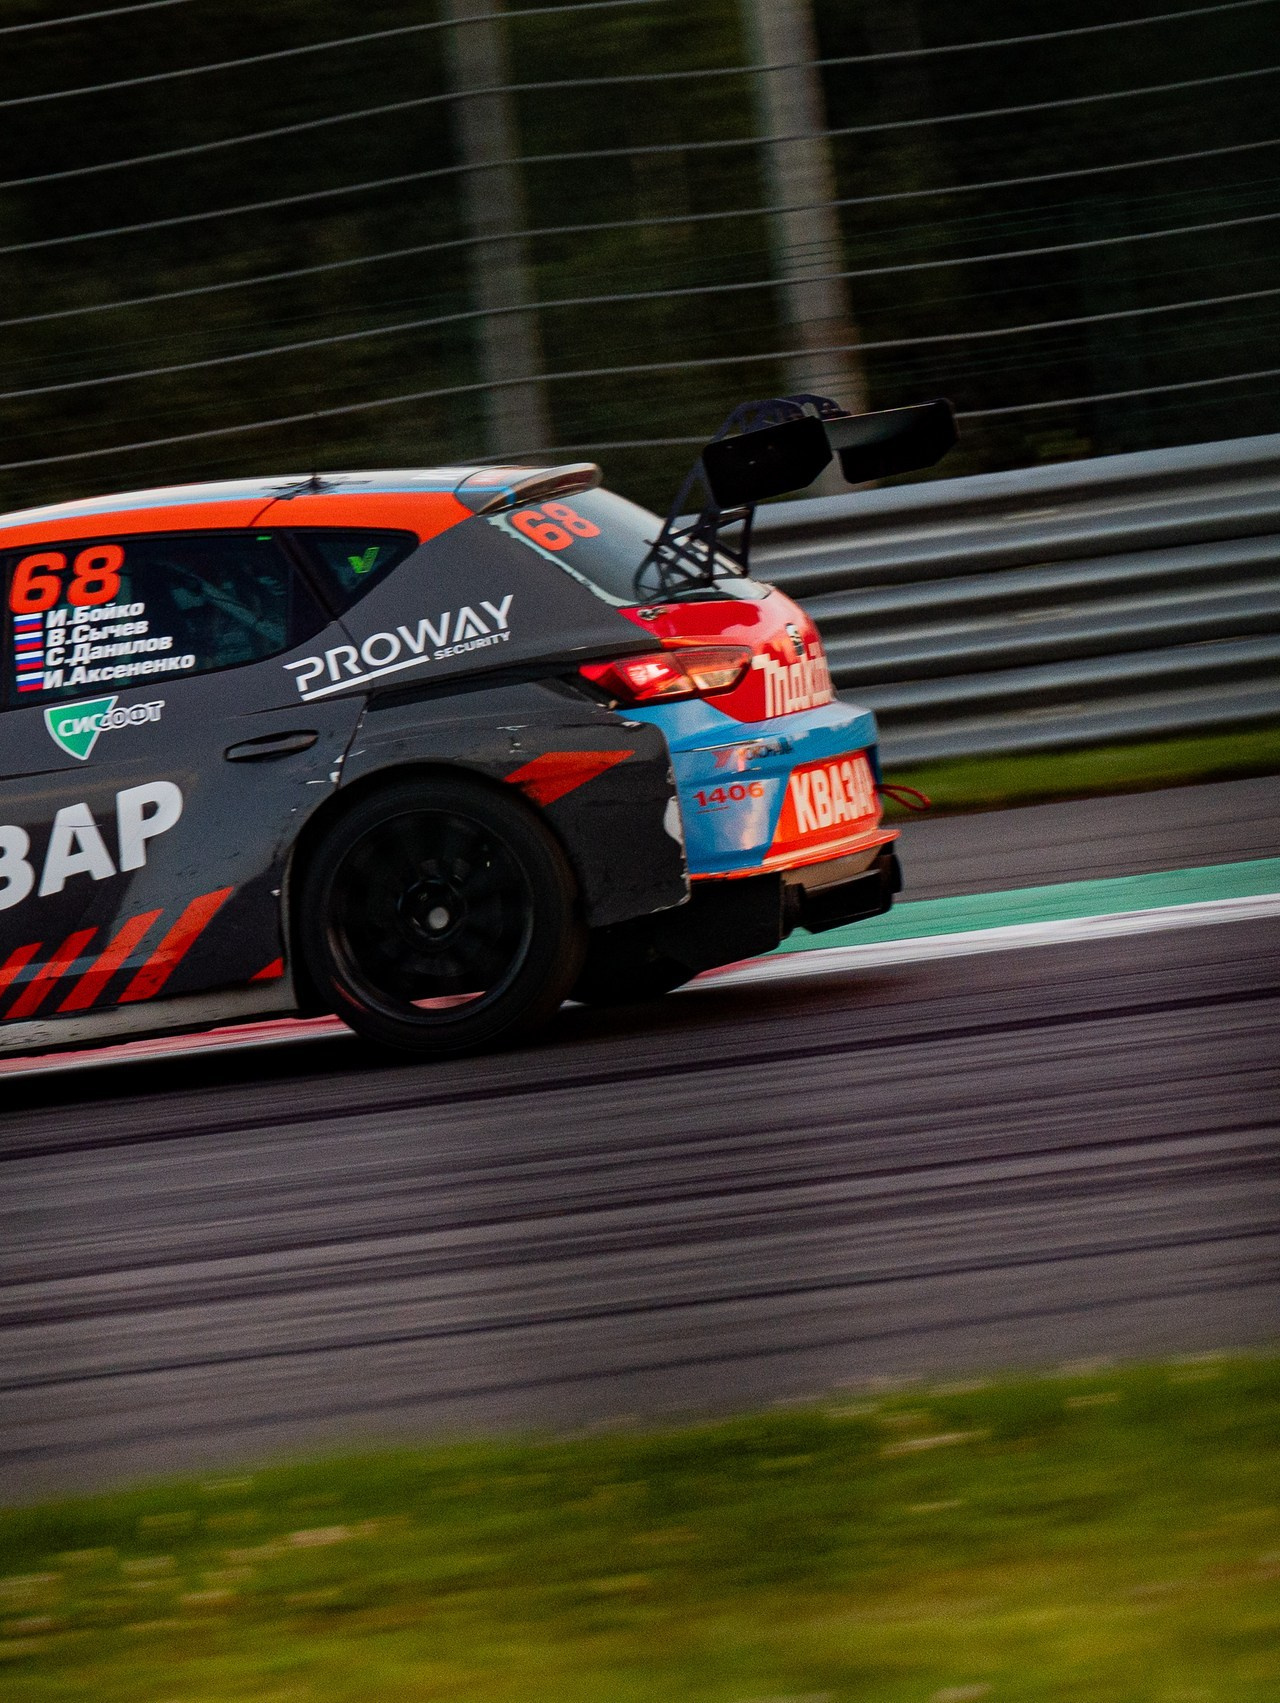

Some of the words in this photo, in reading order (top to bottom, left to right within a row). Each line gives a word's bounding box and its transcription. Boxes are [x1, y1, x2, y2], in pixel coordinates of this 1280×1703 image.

[511, 502, 601, 552] 68
[9, 544, 125, 614] 68
[46, 602, 145, 629] И.Бойко
[46, 620, 149, 648] В.Сычев
[282, 594, 514, 693] PROWAY
[433, 631, 511, 660] SECURITY
[46, 636, 173, 667] С.Данилов
[42, 654, 196, 690] И.Аксененко
[692, 782, 765, 807] 1406
